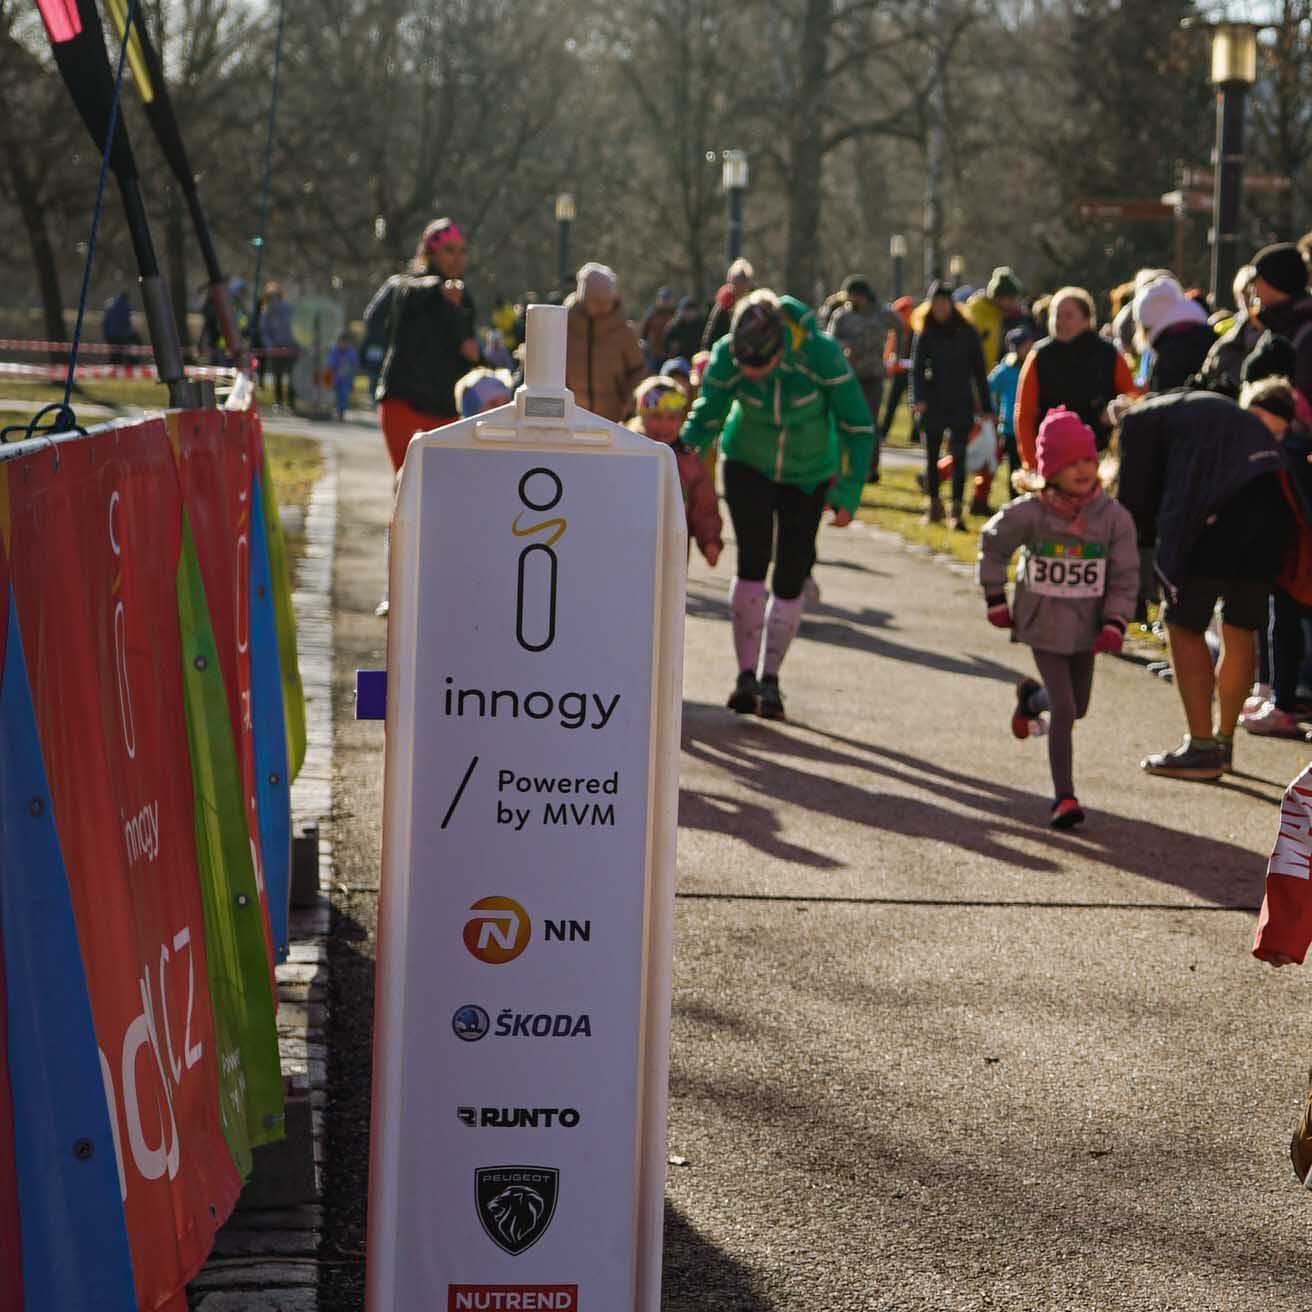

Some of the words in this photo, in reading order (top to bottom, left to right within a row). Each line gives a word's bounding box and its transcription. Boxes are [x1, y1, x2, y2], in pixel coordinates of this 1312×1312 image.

[1034, 559, 1097, 585] 3056
[444, 676, 621, 730] innogy
[498, 769, 619, 795] Powered
[496, 799, 531, 831] by
[542, 803, 616, 827] MVM
[544, 920, 591, 942] NN
[495, 1008, 592, 1038] ŠKODA
[480, 1108, 581, 1128] RUNTO
[482, 1173, 550, 1184] PEUGEOT
[456, 1291, 572, 1311] NUTREND
